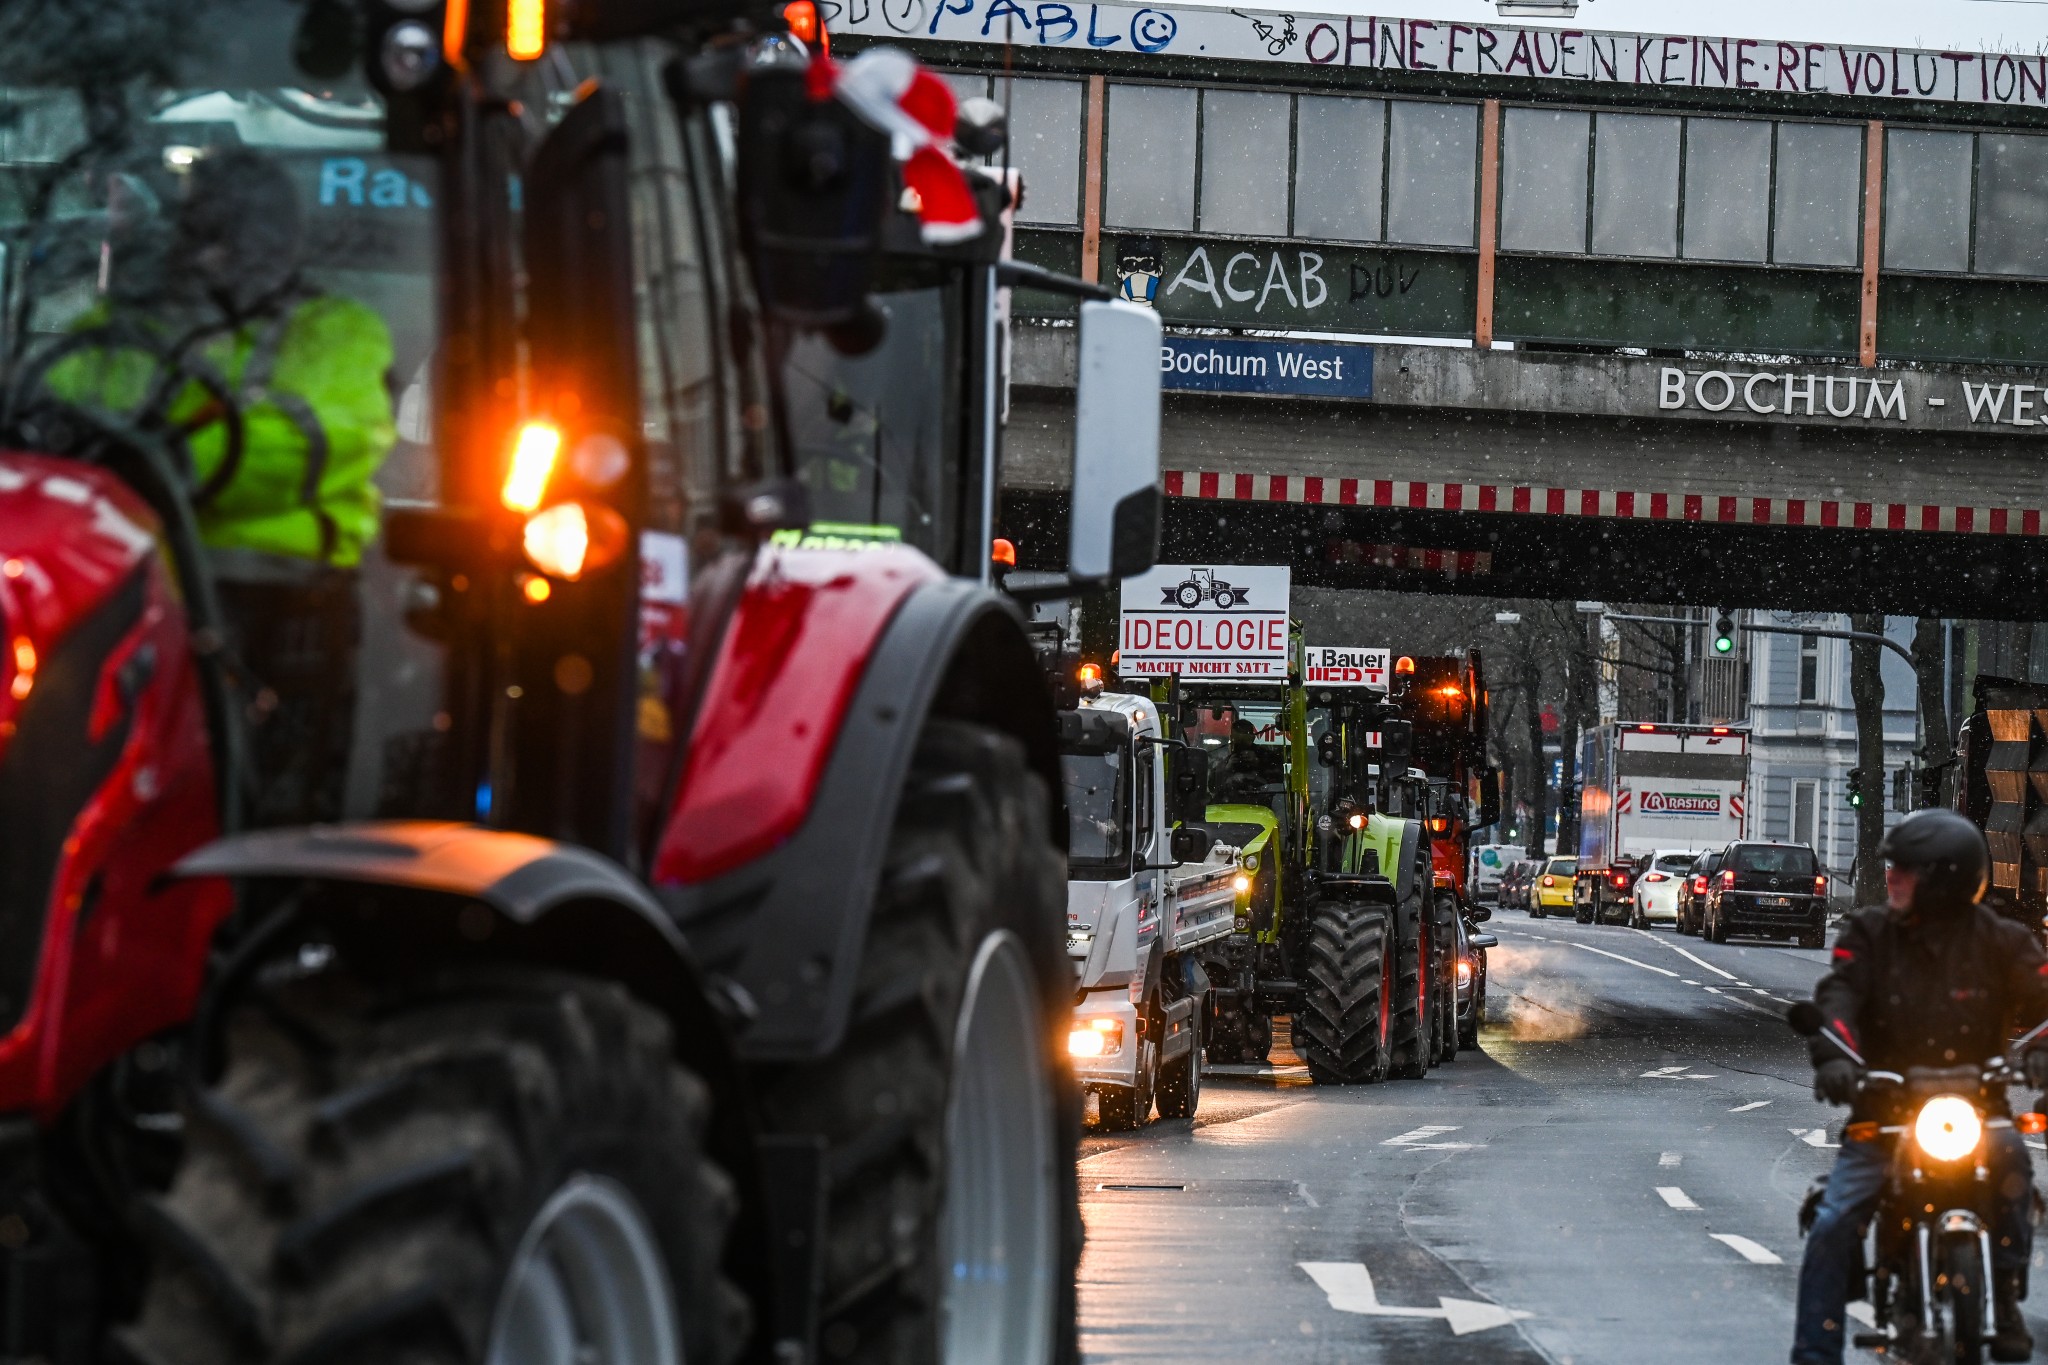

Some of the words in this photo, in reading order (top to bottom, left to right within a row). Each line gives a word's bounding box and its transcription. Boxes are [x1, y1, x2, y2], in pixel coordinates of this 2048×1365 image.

[1166, 246, 1328, 312] ACAB
[1160, 347, 1267, 377] Bochum
[1277, 351, 1343, 380] West
[1659, 367, 1907, 421] BOCHUM
[1125, 619, 1285, 650] IDEOLOGIE
[1136, 661, 1184, 673] MACHT
[1189, 662, 1231, 674] NICHT
[1236, 662, 1271, 674] SATT
[1322, 649, 1386, 668] Bauer
[1669, 797, 1718, 810] RASTING
